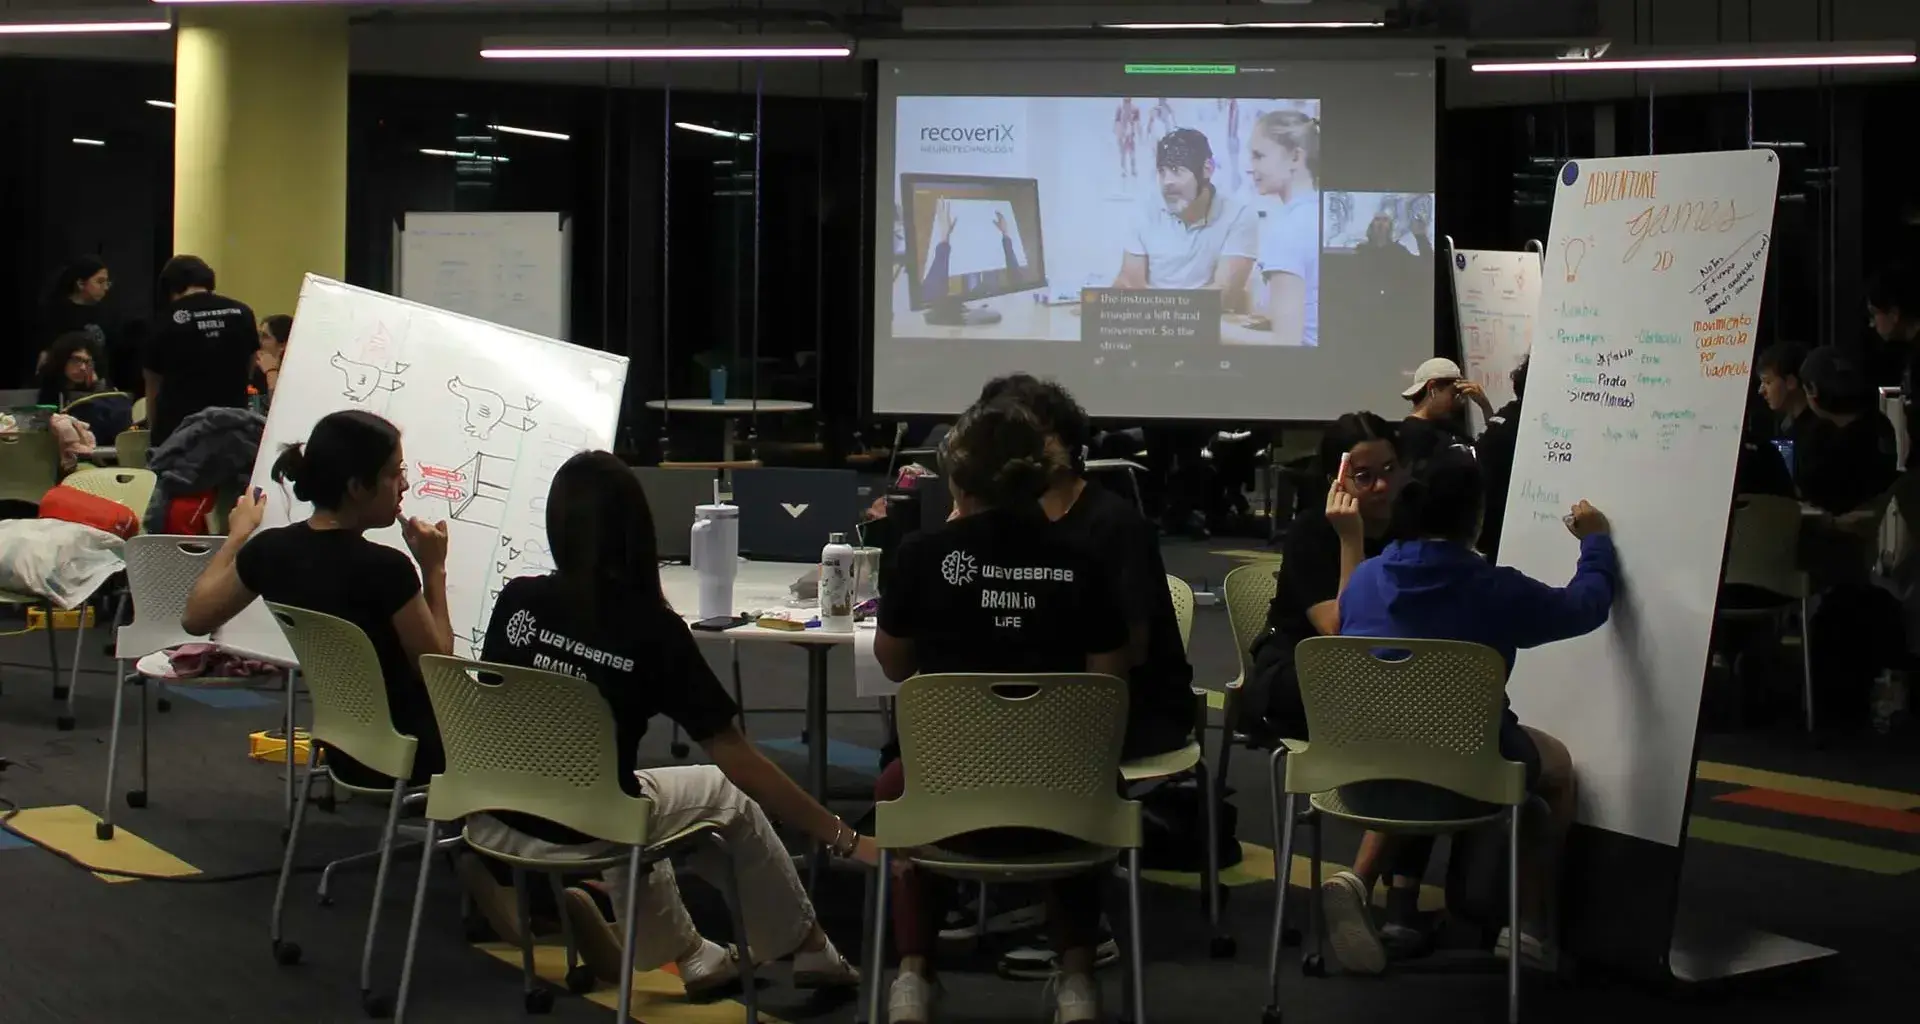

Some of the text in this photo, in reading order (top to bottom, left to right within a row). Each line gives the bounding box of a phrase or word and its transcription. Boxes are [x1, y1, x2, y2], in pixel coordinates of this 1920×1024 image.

[920, 124, 1015, 141] recoveriX
[1584, 170, 1659, 208] ADVENTURE
[1623, 198, 1760, 263] games
[1652, 250, 1675, 272] 2D
[1101, 291, 1190, 305] the instruction to
[1100, 308, 1200, 321] imagine a left hand
[1161, 325, 1174, 336] So
[1177, 326, 1195, 336] the
[1598, 372, 1627, 387] Pirata
[982, 565, 1074, 582] wavesense
[981, 589, 1036, 609] BR41N.io
[539, 628, 635, 672] wavesense
